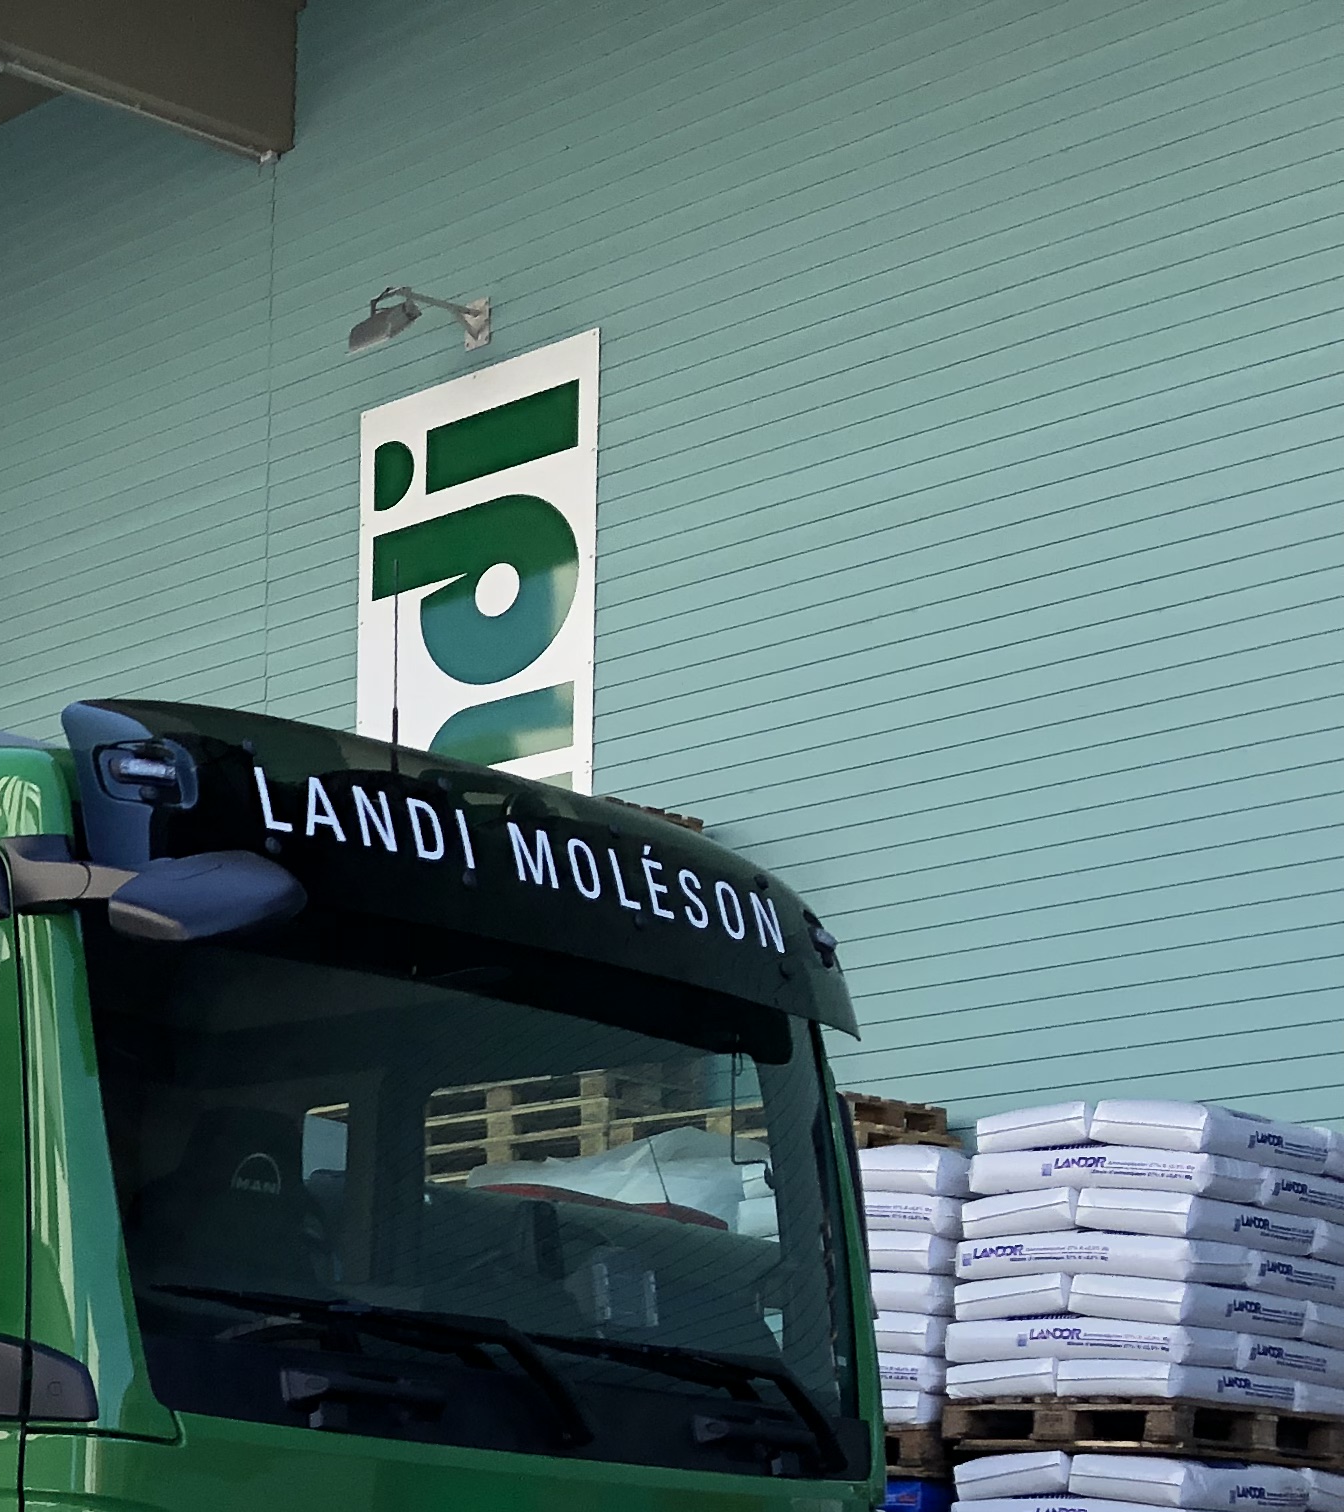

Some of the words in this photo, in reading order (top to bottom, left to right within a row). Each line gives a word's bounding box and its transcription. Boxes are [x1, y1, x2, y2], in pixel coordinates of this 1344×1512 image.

[253, 765, 477, 870] LANDI
[506, 821, 786, 955] MOLÉSON
[1054, 1156, 1107, 1170] LANDOR
[1029, 1327, 1082, 1340] LANDOR
